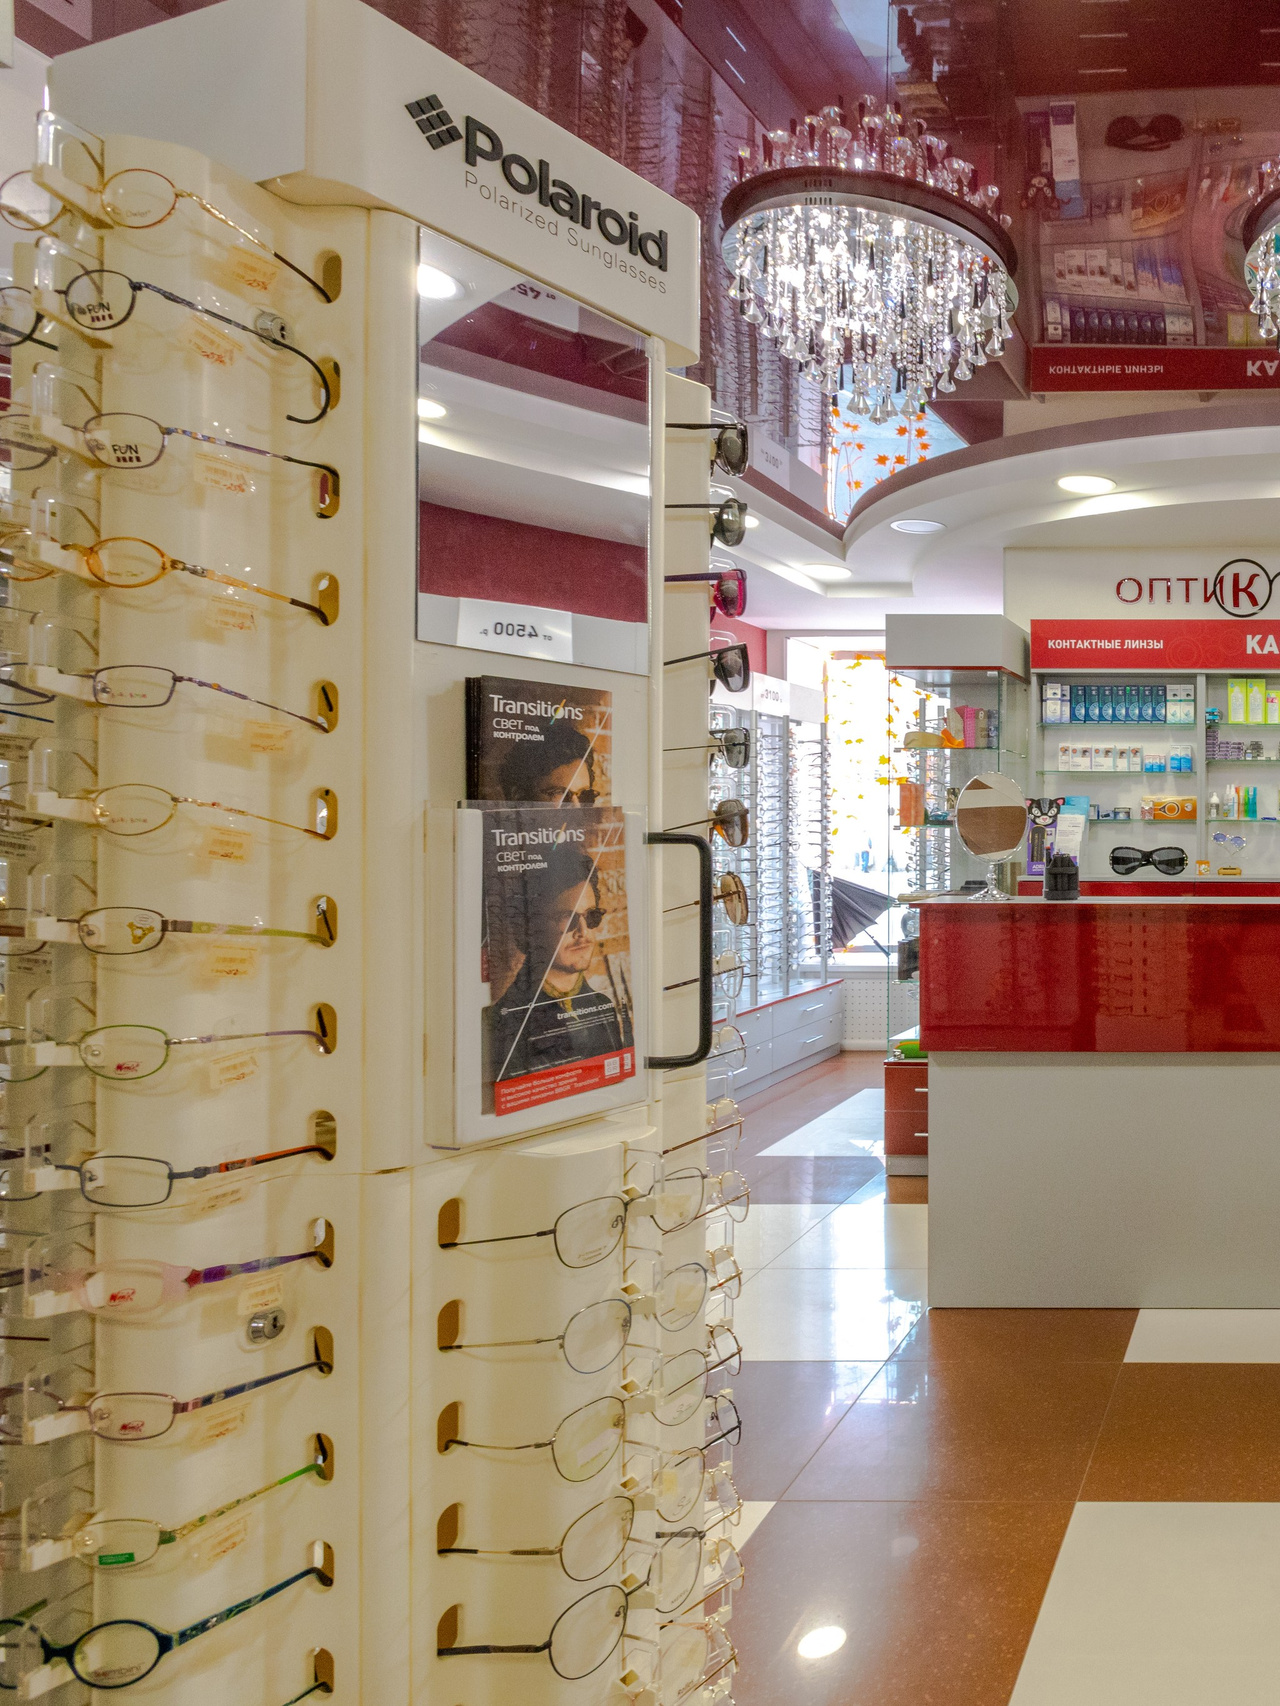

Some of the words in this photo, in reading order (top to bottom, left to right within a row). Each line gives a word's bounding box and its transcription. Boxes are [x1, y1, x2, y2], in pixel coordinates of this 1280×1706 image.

[465, 115, 668, 272] Polaroid
[465, 170, 559, 236] Polarized
[567, 227, 667, 294] Sunglasses
[112, 444, 139, 455] FUN
[1048, 639, 1122, 649] КОНТАКТНЫЕ
[1123, 639, 1164, 649] ЛИНЗЫ
[489, 694, 584, 721] Transitions
[493, 731, 545, 742] контролем
[491, 827, 585, 846] Transitions
[497, 862, 548, 873] контролем
[557, 1002, 614, 1020] transitions.com
